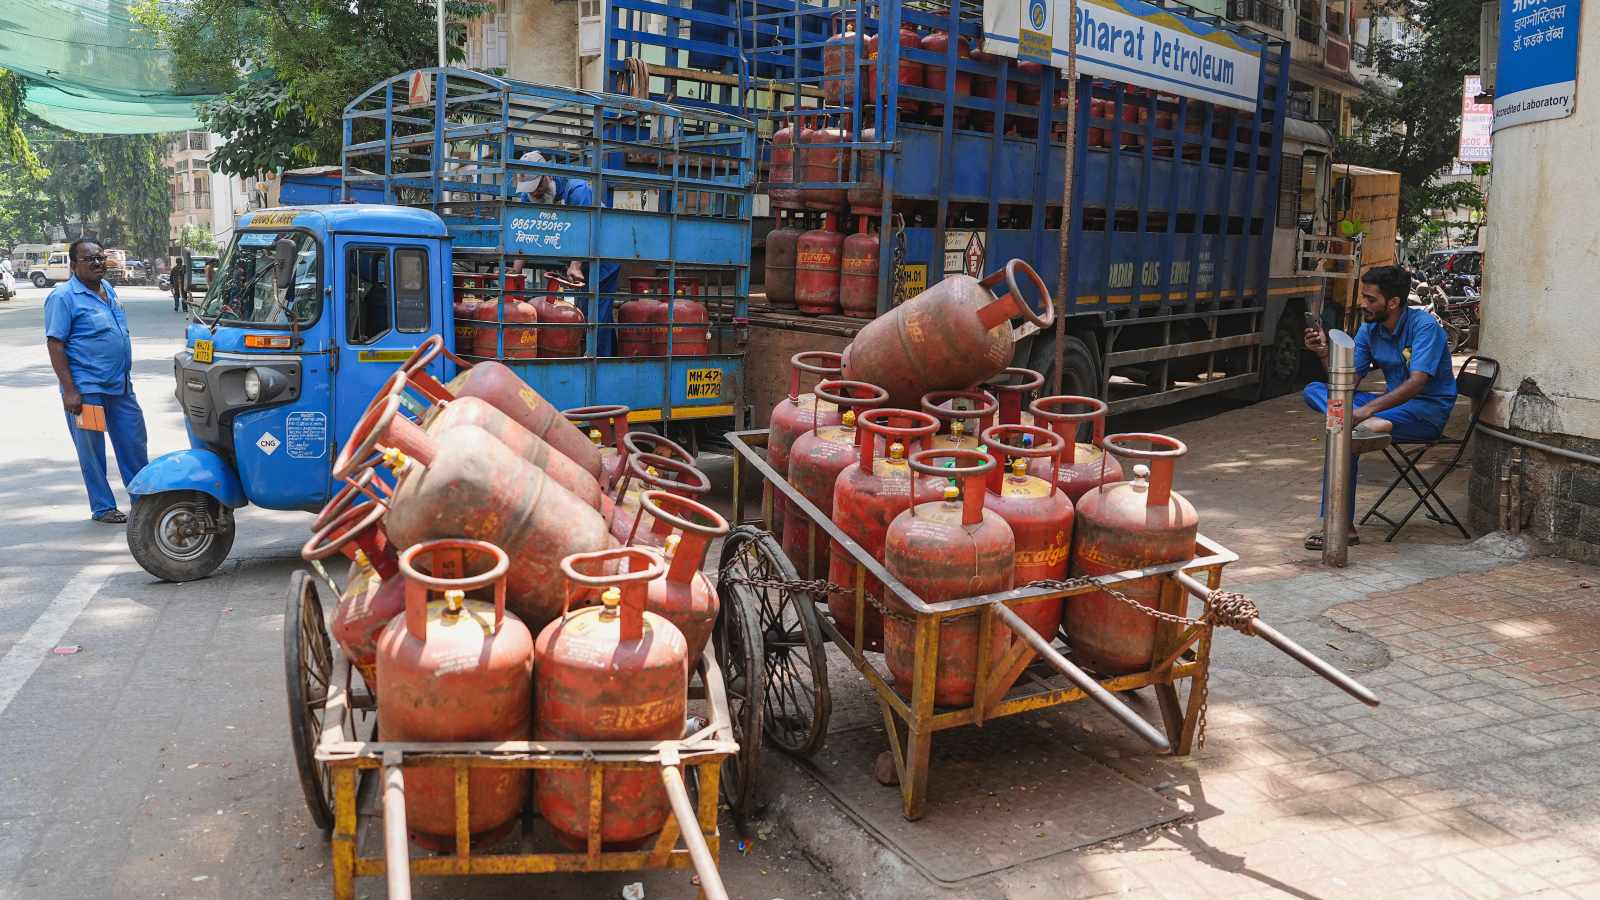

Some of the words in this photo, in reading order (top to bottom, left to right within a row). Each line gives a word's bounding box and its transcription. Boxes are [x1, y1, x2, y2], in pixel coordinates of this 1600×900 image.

[1074, 8, 1145, 61] Bharat
[1152, 31, 1234, 86] Petroleum
[1522, 96, 1569, 112] Laboratory
